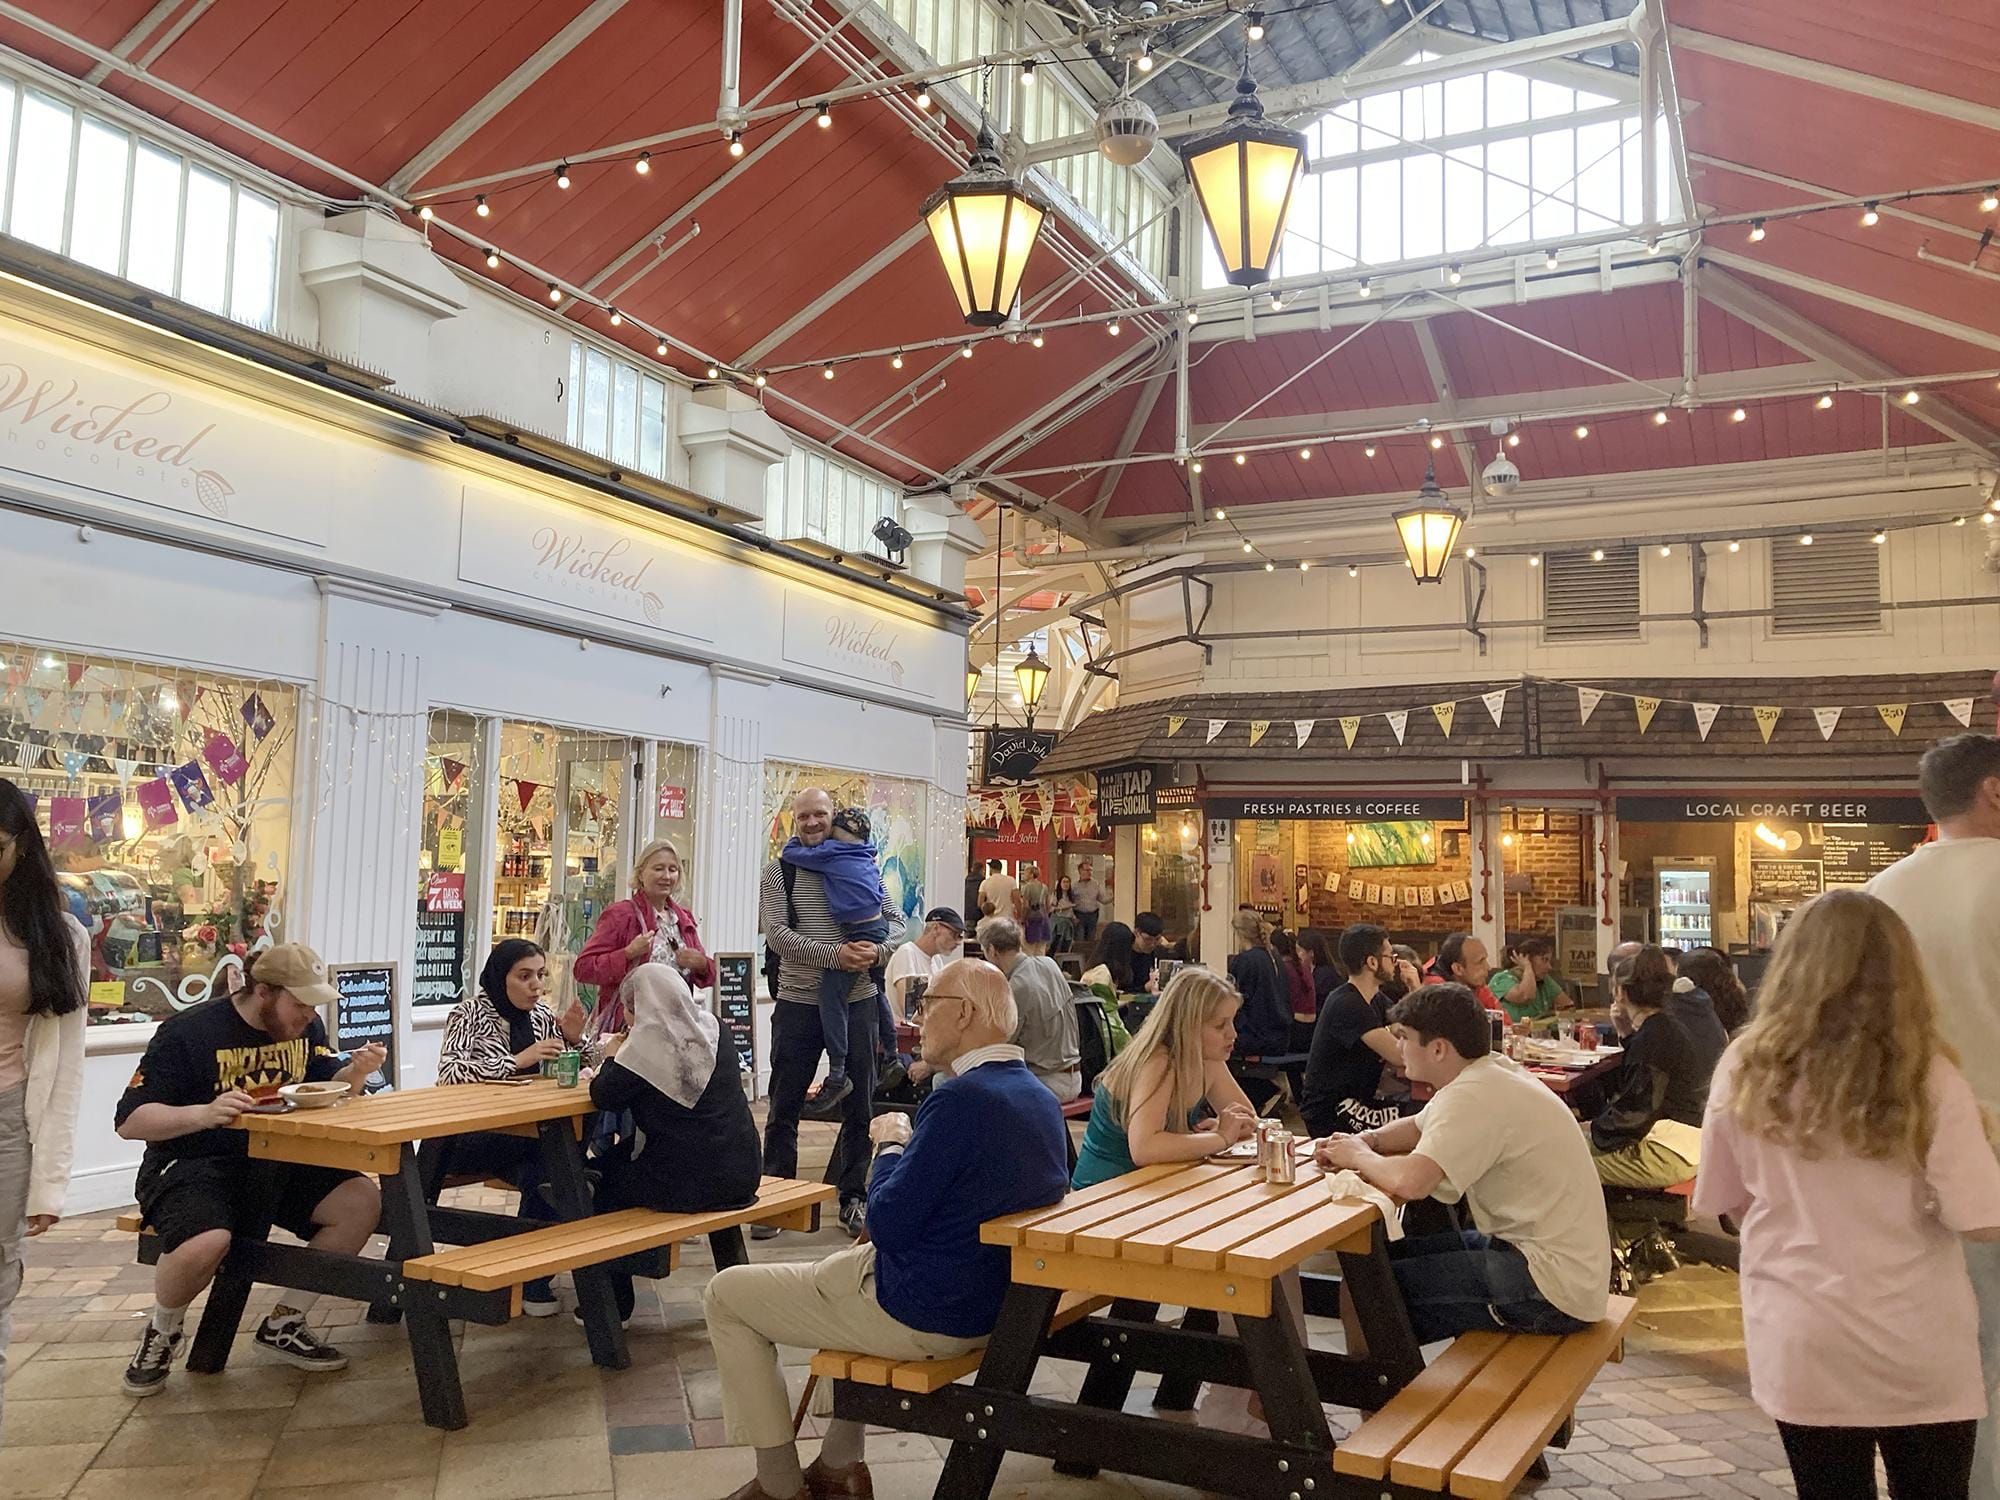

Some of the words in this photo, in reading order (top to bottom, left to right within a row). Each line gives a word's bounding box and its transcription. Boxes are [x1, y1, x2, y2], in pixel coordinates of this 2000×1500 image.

[0, 363, 217, 467] Wicked
[7, 427, 190, 489] hocolate
[532, 527, 654, 592] Wicked
[825, 615, 898, 662] Wicked
[1435, 706, 1453, 716] 250
[1638, 699, 1657, 712] 250
[1757, 709, 1778, 721] 250
[1881, 707, 1904, 719] 250
[1253, 723, 1267, 732] 250
[1341, 719, 1358, 729] 250
[992, 738, 1026, 766] David
[1027, 740, 1049, 760] Joh
[1123, 769, 1152, 795] TAP
[1101, 784, 1122, 800] MARKET
[1101, 799, 1114, 817] TAP
[1123, 794, 1151, 816] SOCIAL
[1243, 803, 1284, 815] FRESH
[1289, 803, 1352, 815] PASTRIES
[1355, 804, 1362, 815] &
[1365, 803, 1421, 815] COFFEE
[1686, 803, 1745, 817] LOCAL
[1751, 803, 1814, 817] CRAFT
[1820, 804, 1867, 817] BEER
[1017, 832, 1040, 845] John
[431, 873, 447, 886] Open
[429, 887, 442, 911] 7
[443, 887, 460, 900] DAYS
[436, 899, 443, 910] A
[443, 899, 463, 910] WEEK
[442, 929, 456, 943] ASK
[428, 948, 456, 962] QUESTIONS
[1569, 949, 1597, 961] TAP
